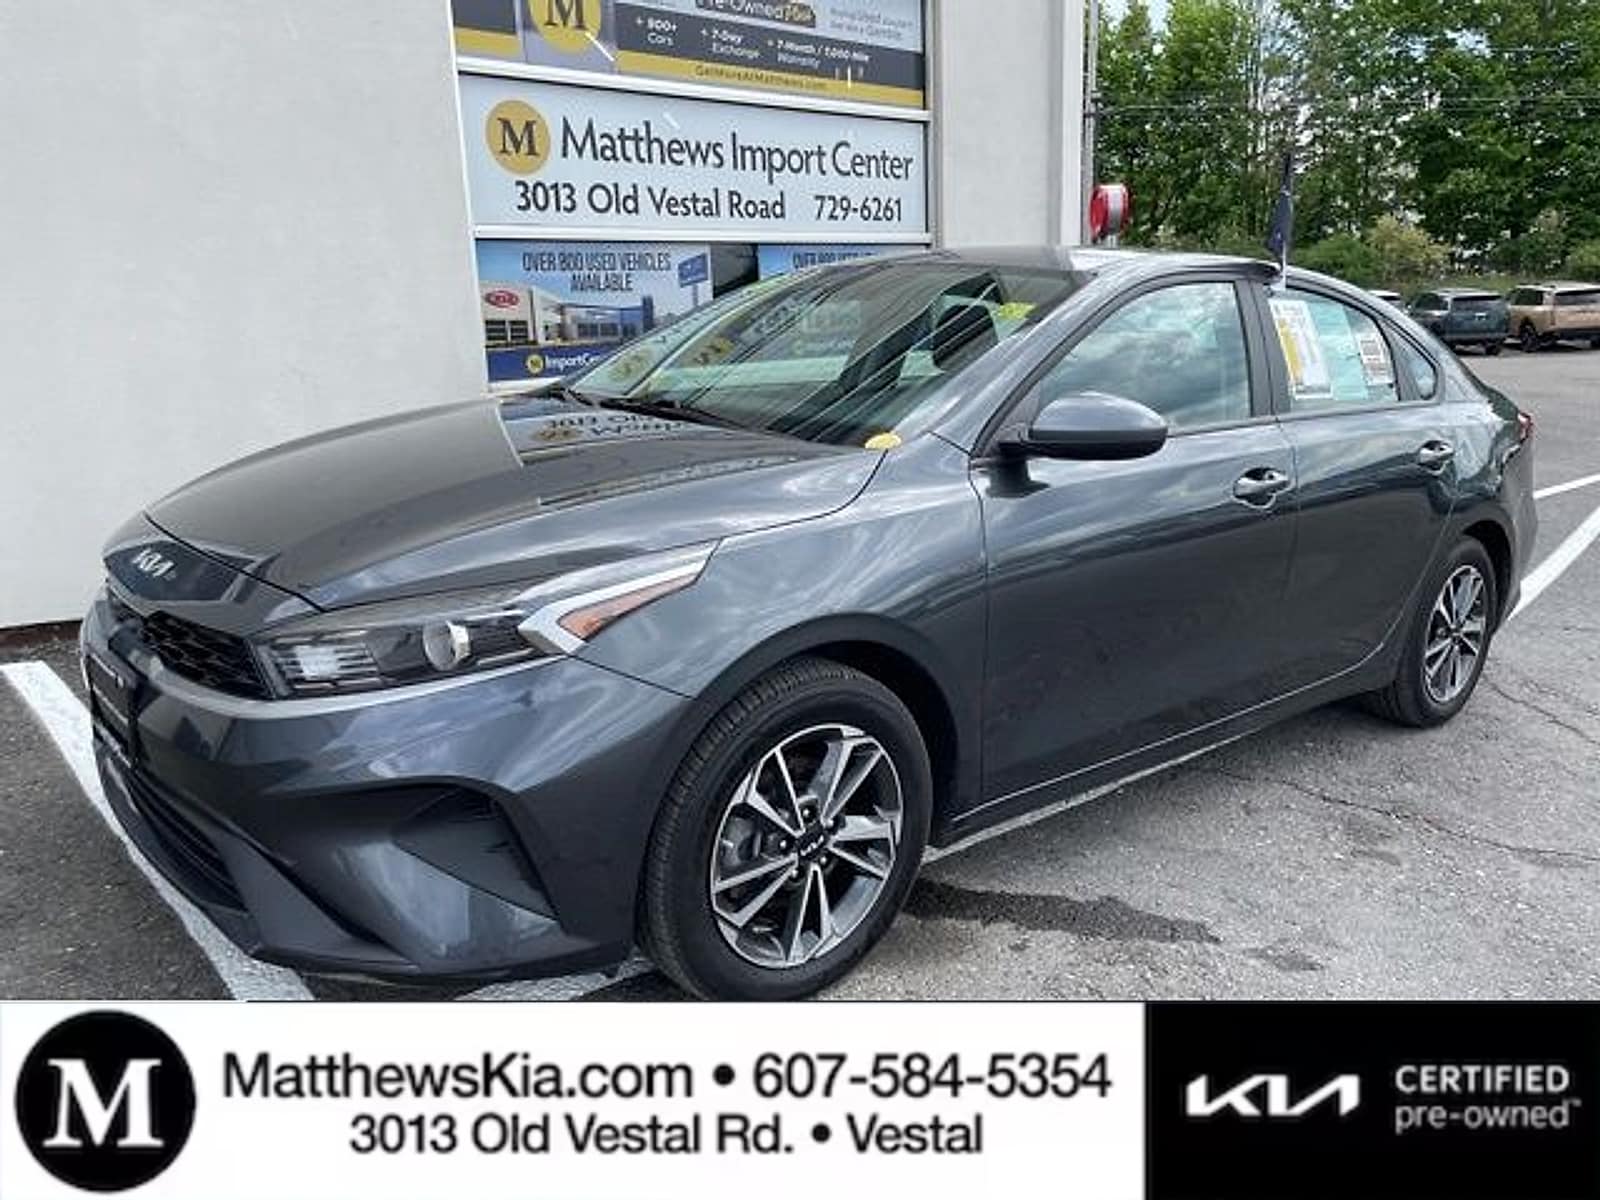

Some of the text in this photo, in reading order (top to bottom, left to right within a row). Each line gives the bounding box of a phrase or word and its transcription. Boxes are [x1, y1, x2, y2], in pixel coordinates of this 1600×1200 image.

[544, 0, 589, 30] M
[497, 117, 540, 156] M
[562, 115, 914, 185] Matthews Import Center
[514, 180, 903, 222] 3013 Old Vestal Road 729-6261
[522, 252, 556, 271] OVER
[557, 252, 583, 271] 800
[584, 252, 616, 271] USED
[617, 252, 672, 271] VEHICLES
[570, 273, 633, 291] AVAILABLE
